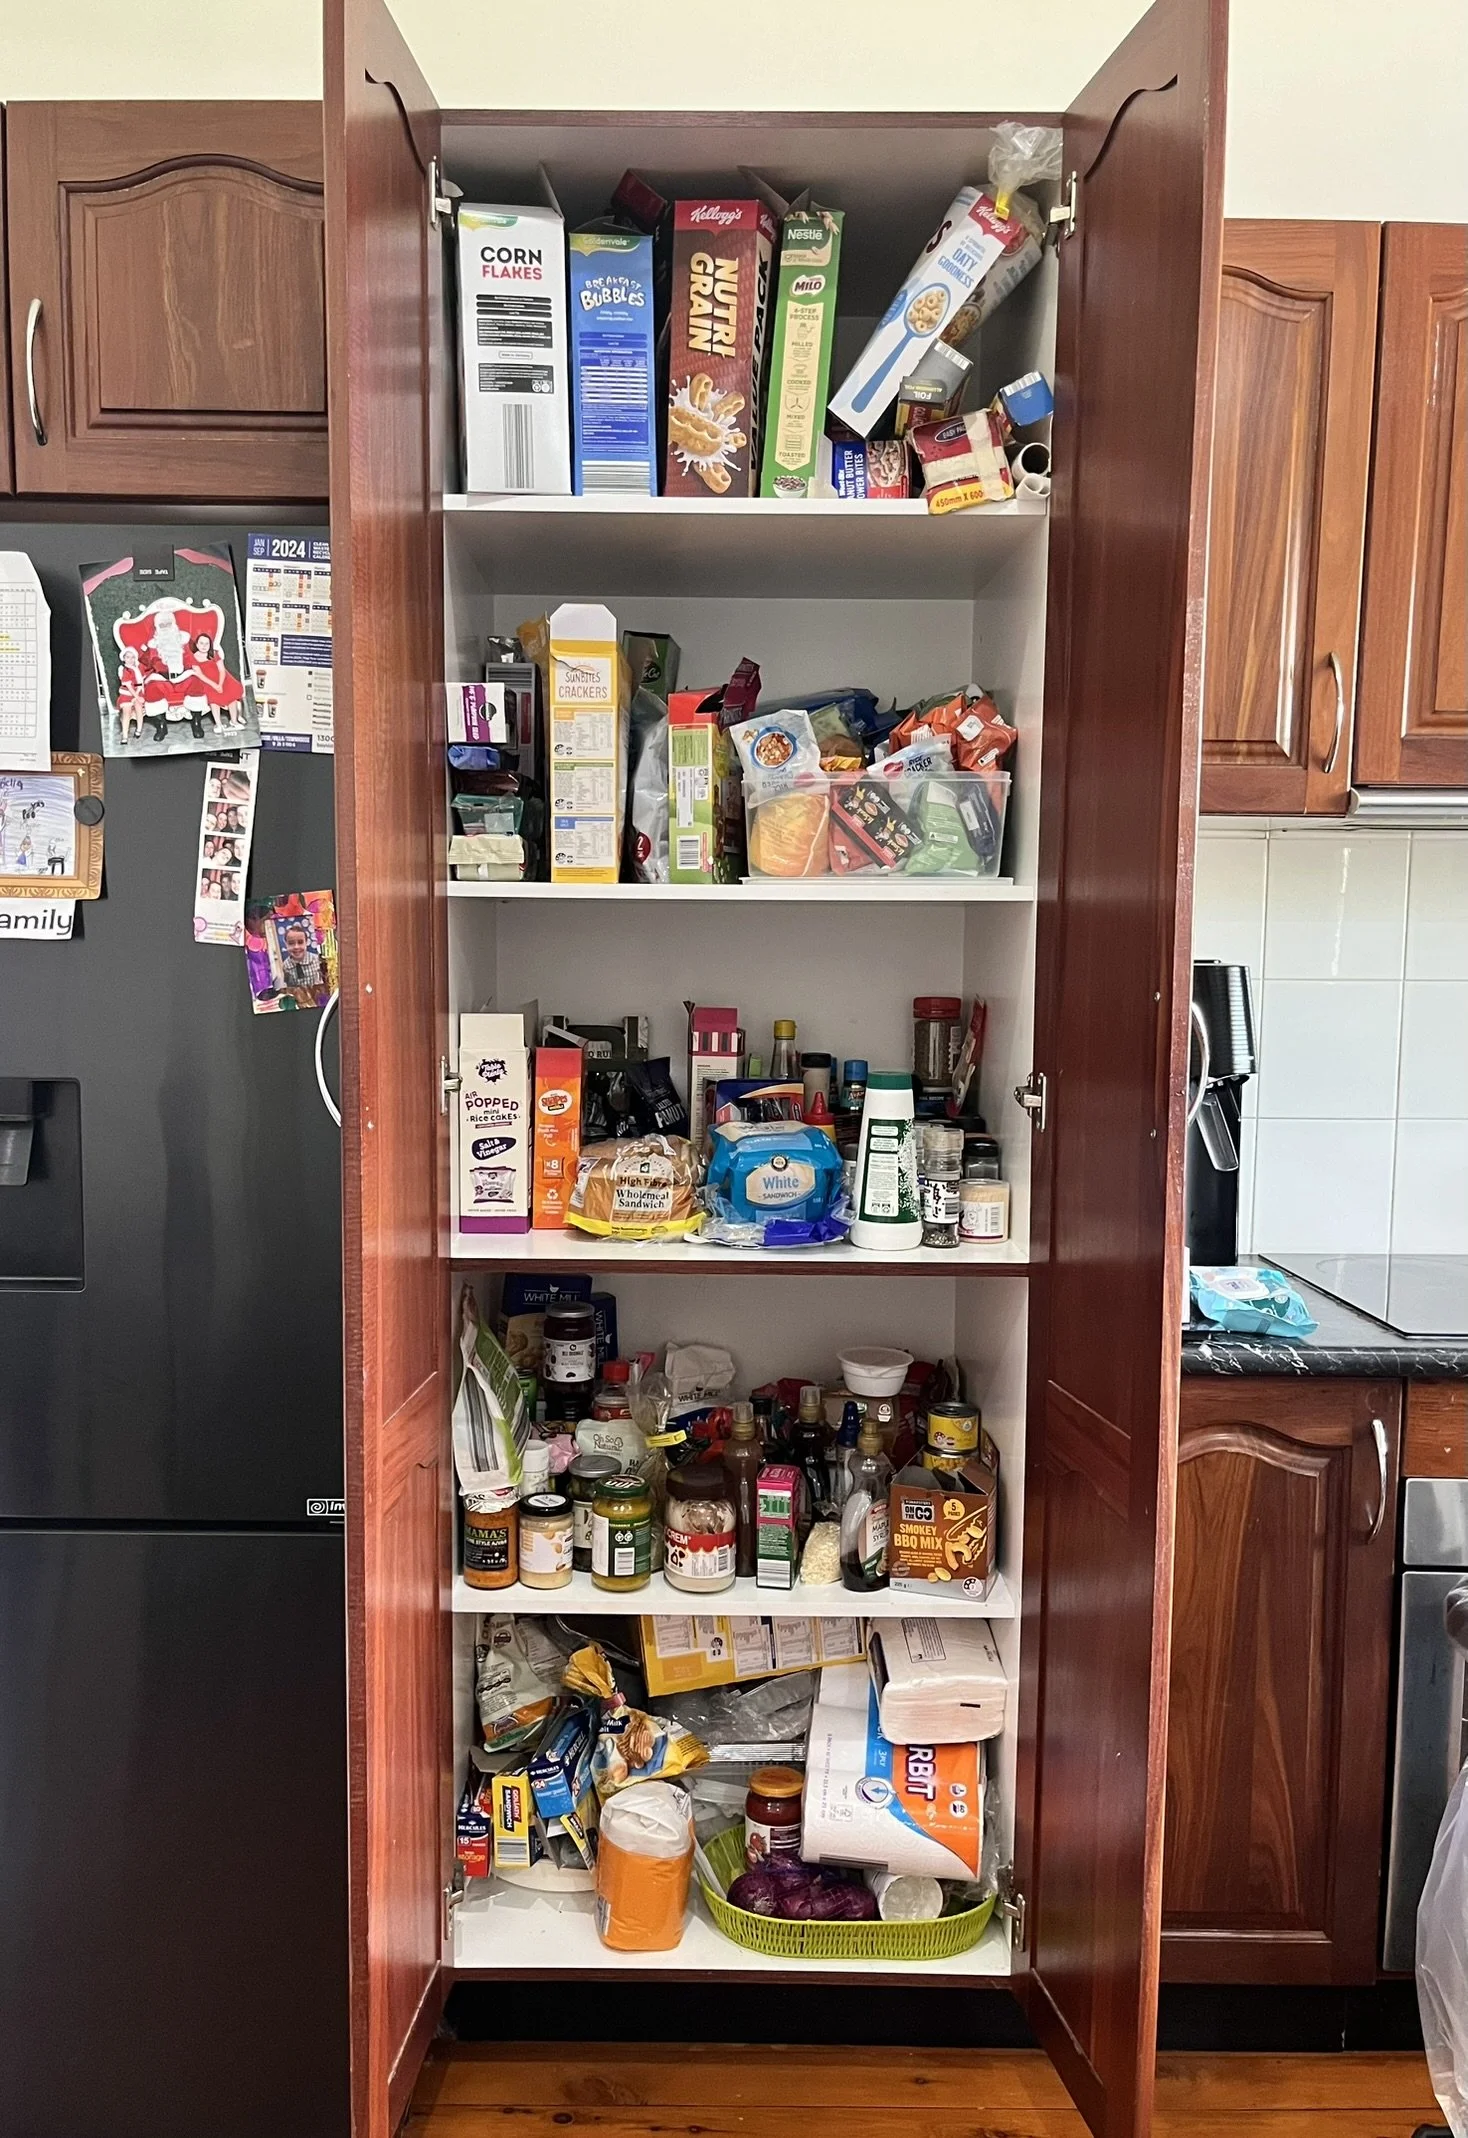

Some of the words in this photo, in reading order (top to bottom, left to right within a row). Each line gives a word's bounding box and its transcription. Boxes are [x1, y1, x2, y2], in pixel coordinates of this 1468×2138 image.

[691, 205, 743, 225] Kellogg's
[480, 246, 543, 266] CORN
[951, 248, 979, 271] OATY
[482, 264, 543, 281] FLAKES
[937, 256, 975, 290] GOODNESS
[585, 276, 642, 292] BREAKFAST
[794, 281, 822, 292] MILO
[579, 287, 646, 312] BUBBLES
[688, 251, 714, 356] GRAIN
[754, 249, 769, 353] PACK
[711, 257, 739, 359] NUTRI
[913, 391, 933, 400] FOIL
[844, 450, 854, 479] BUTTER
[854, 453, 864, 476] BITES
[855, 477, 866, 499] OWER
[936, 495, 963, 508] 450mm
[252, 547, 265, 556] SEP
[253, 538, 265, 547] JAN
[271, 539, 306, 558] 2024
[565, 671, 601, 684] SUNBITES
[558, 686, 608, 699] CRACKERS
[464, 1090, 478, 1101] AIR
[465, 1097, 519, 1111] POPPED
[476, 1143, 508, 1158] Vinegar
[478, 1139, 494, 1150] Salt
[619, 1176, 642, 1187] High
[644, 1178, 668, 1188] Fibre
[762, 1176, 799, 1190] White
[616, 1189, 669, 1200] Wholemeal
[762, 1192, 797, 1200] SANDWICH
[618, 1200, 665, 1209] Sandwich
[524, 1292, 556, 1302] WHITE
[595, 1311, 604, 1346] WHITE
[605, 1435, 613, 1443] So
[905, 1505, 914, 1514] ON
[915, 1506, 932, 1520] GO
[951, 1502, 957, 1511] 5
[899, 1523, 937, 1536] SMOKEY
[893, 1533, 918, 1550] BBQ
[920, 1536, 943, 1551] MIX
[907, 1746, 934, 1801] RBIT
[504, 1789, 512, 1828] SANDWICH
[459, 1836, 470, 1845] 15
